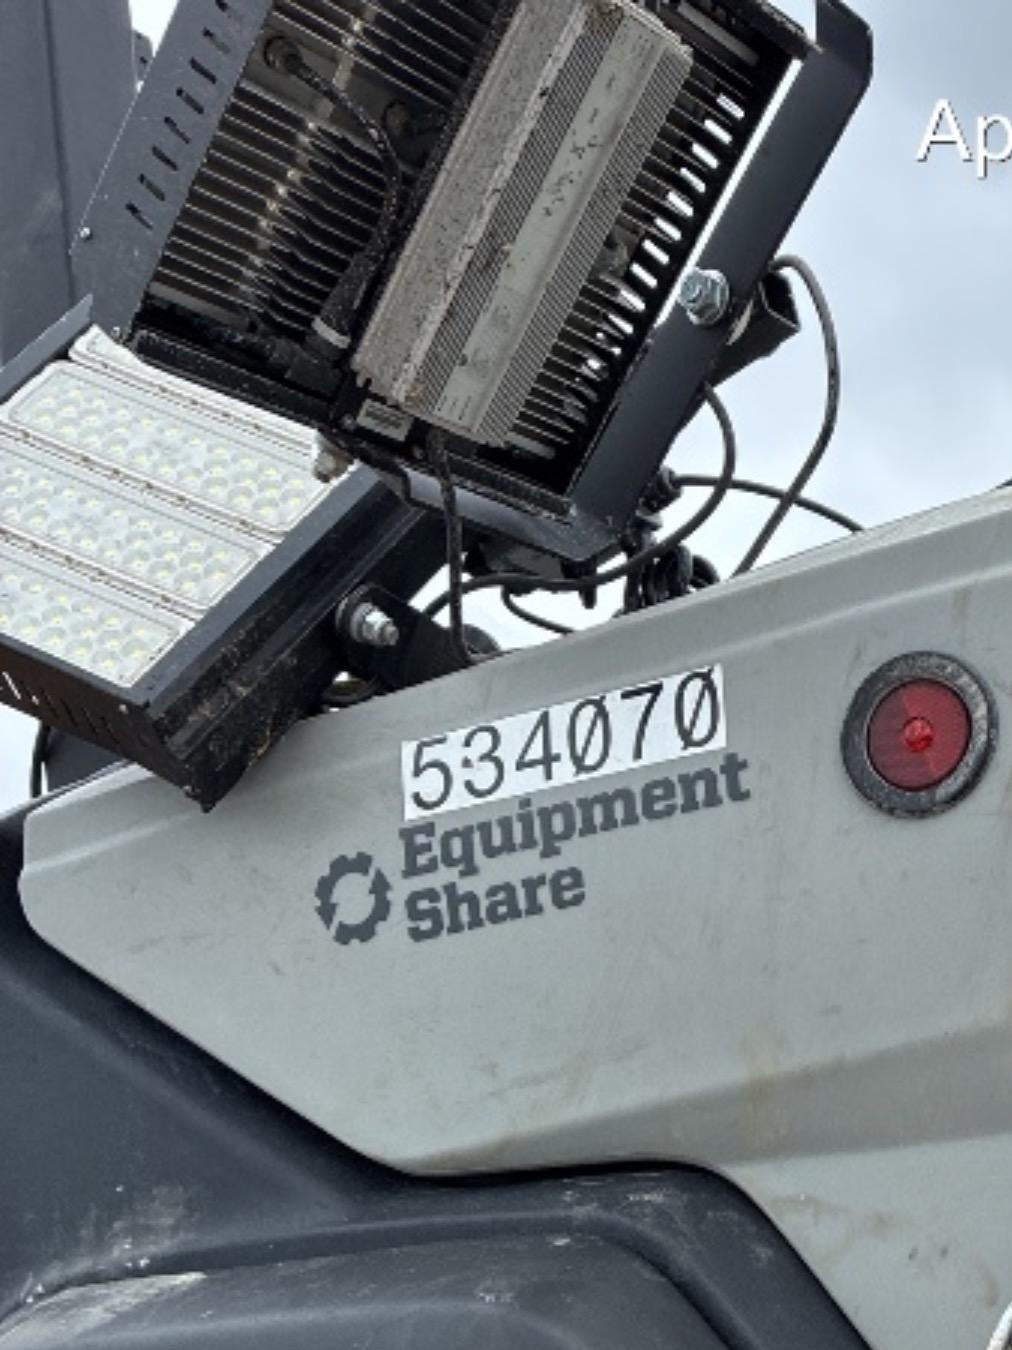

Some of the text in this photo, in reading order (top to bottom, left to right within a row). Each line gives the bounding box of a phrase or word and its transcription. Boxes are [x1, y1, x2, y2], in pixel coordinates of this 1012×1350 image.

[410, 665, 723, 811] 534070
[399, 751, 752, 879] Equipment
[404, 864, 587, 943] Share
